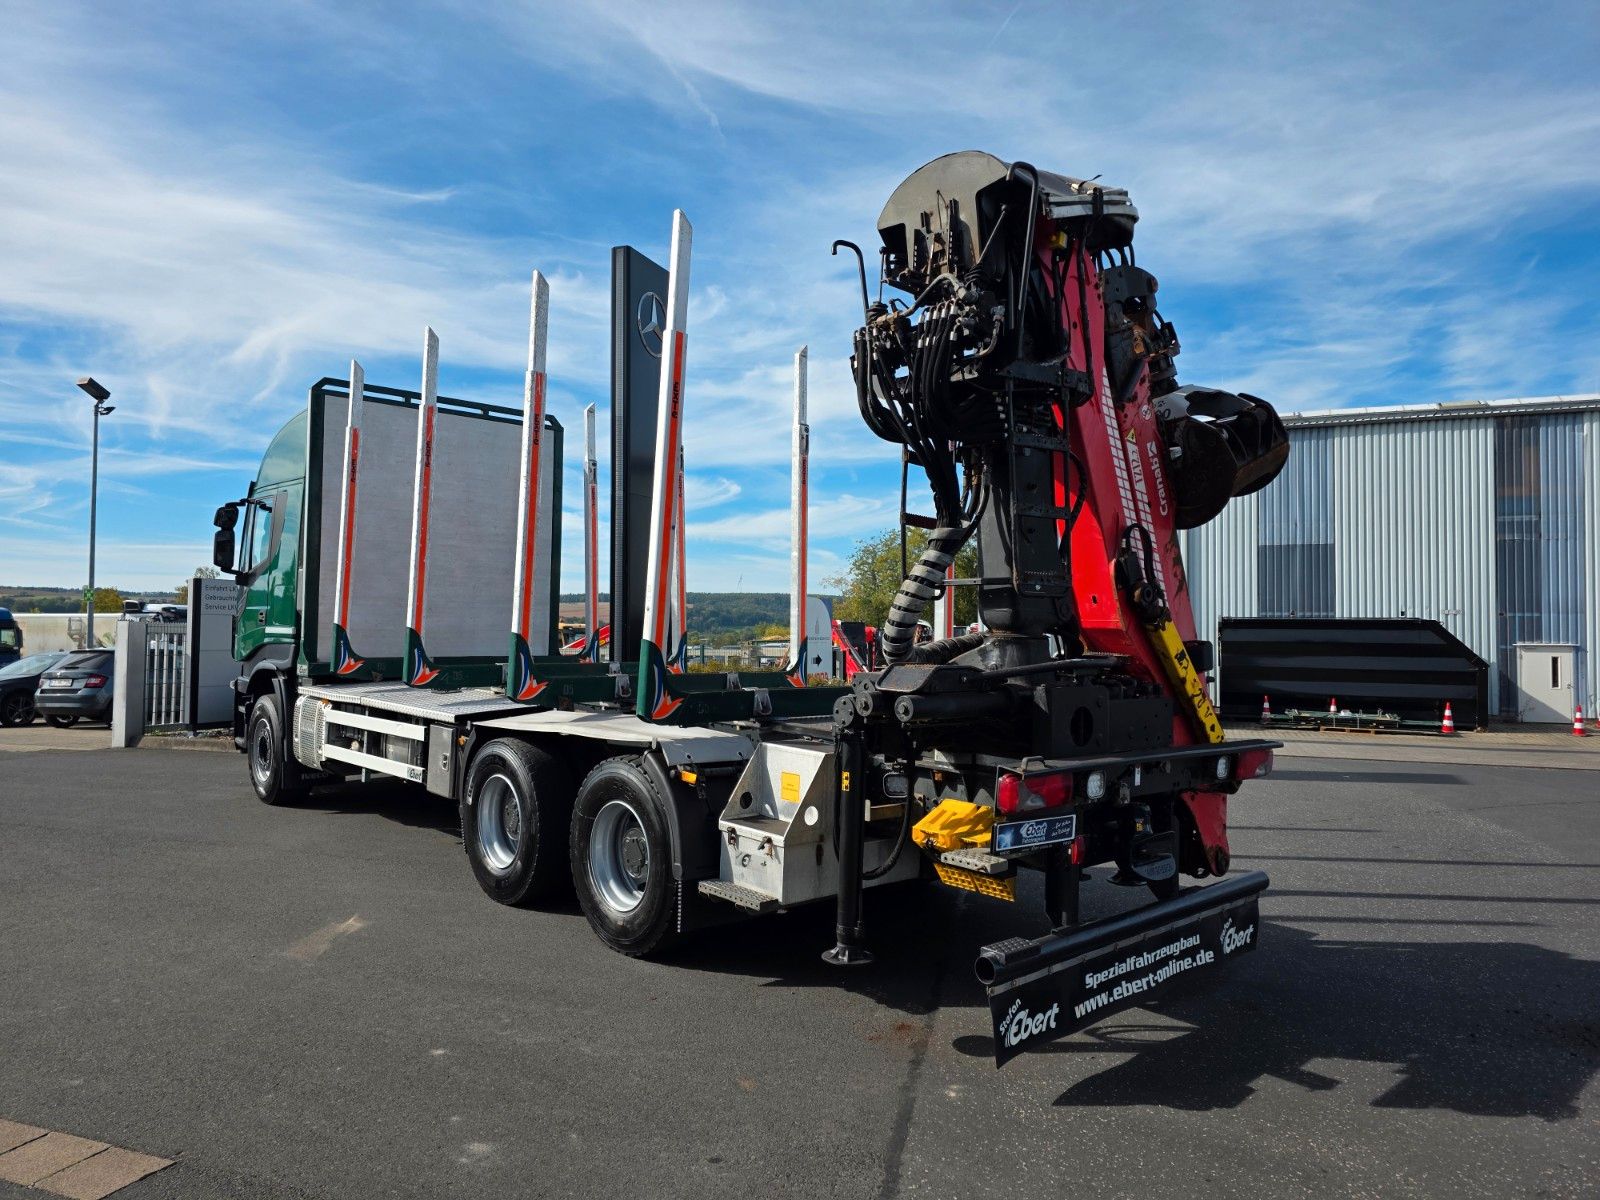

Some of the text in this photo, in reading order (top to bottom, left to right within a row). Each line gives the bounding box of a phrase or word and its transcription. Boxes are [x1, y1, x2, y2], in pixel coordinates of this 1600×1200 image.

[1151, 457, 1168, 516] Cranab
[1085, 934, 1200, 988] Spezialfahrzeugbau
[1224, 925, 1254, 953] Ebert
[1074, 949, 1214, 1019] www.ebert-online.de
[1009, 1003, 1059, 1046] Ebert
